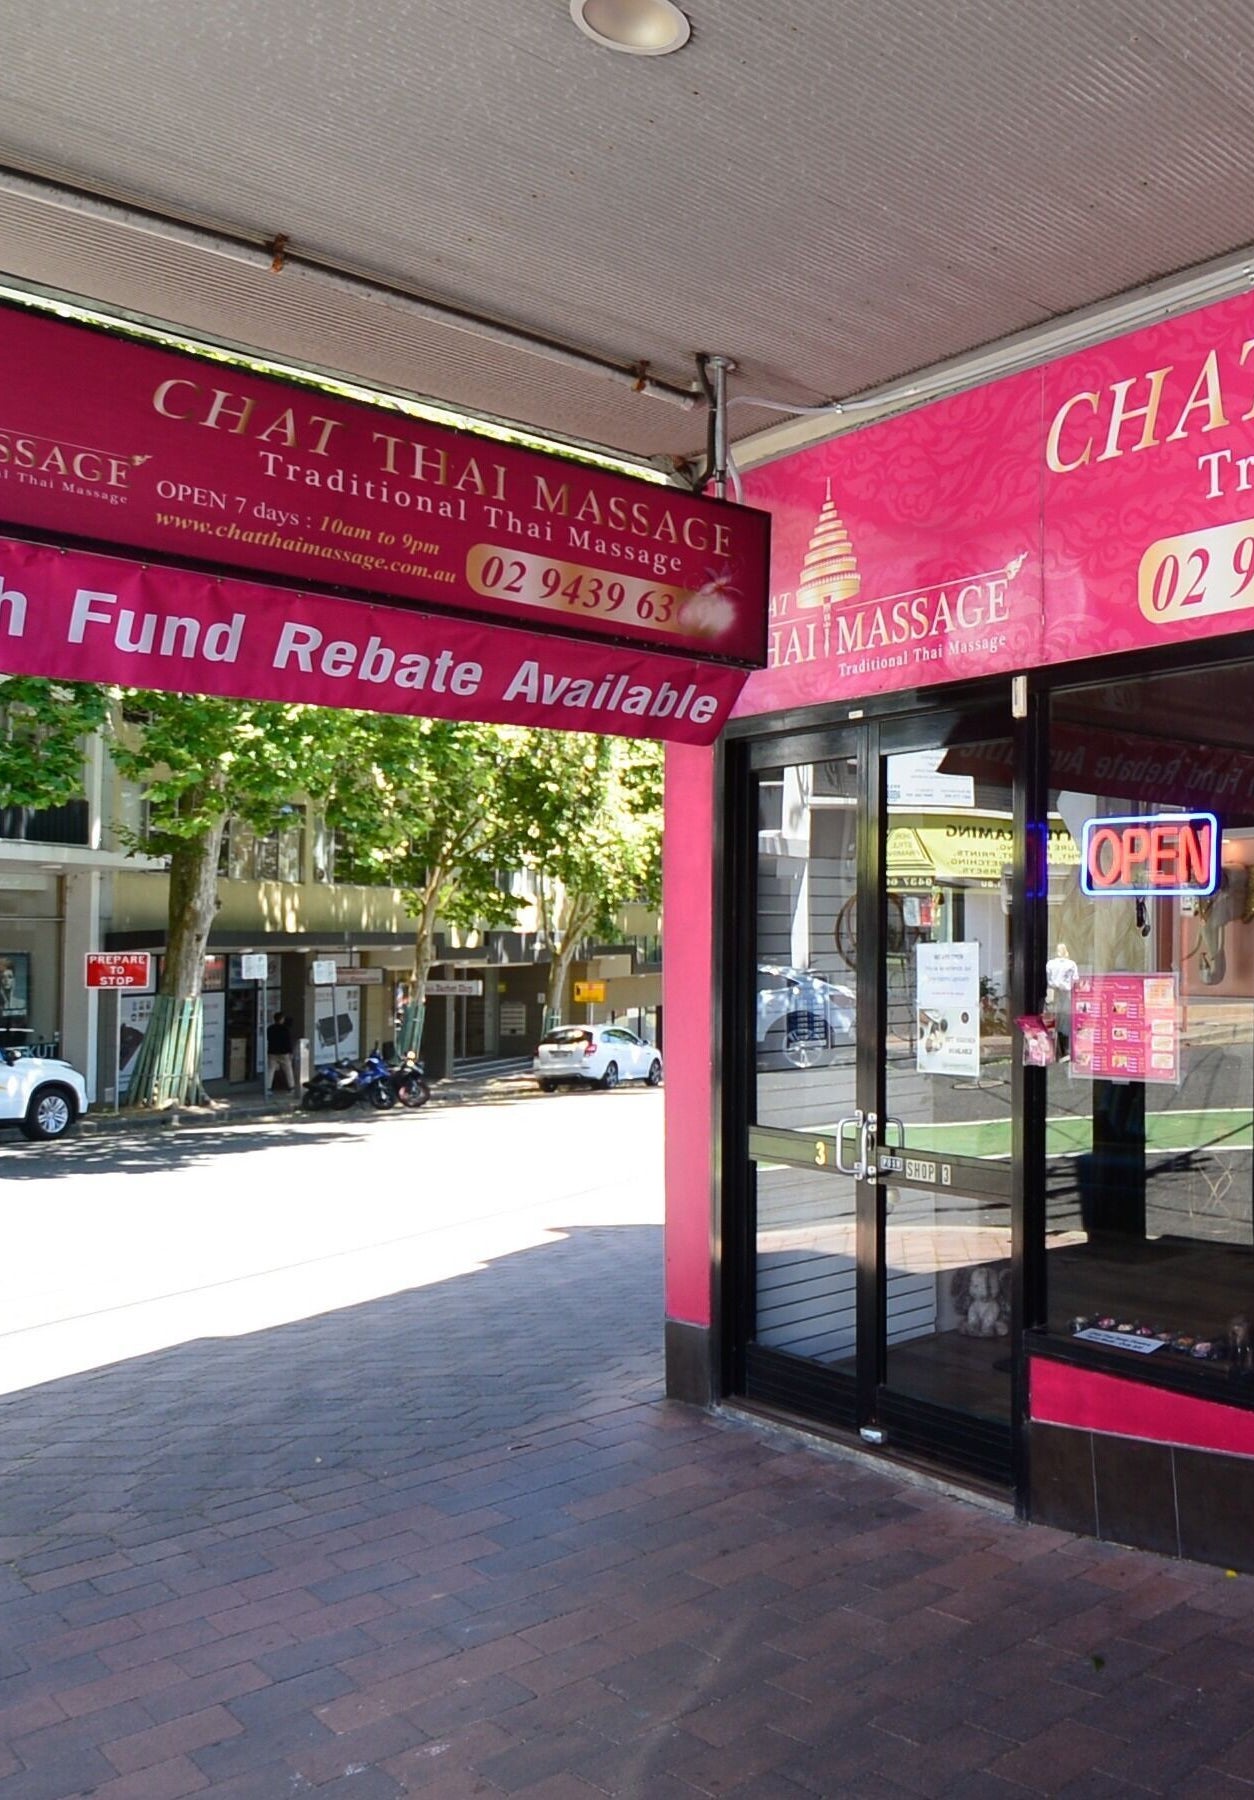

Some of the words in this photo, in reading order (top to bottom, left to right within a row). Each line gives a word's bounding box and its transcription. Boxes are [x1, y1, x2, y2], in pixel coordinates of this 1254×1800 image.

[17, 472, 54, 489] Thai
[62, 482, 128, 505] Massage
[153, 378, 345, 458] CHAT
[373, 431, 507, 501] THAI
[534, 475, 733, 557] MASSAGE
[157, 480, 227, 511] OPEN
[236, 497, 247, 514] 7
[253, 499, 300, 527] days
[319, 515, 371, 541] 10am
[378, 523, 395, 546] to
[401, 534, 440, 557] 9pm
[259, 451, 467, 521] Traditional
[484, 505, 553, 541] Thai
[568, 526, 683, 575] Massage
[156, 510, 457, 584] www.chatthaimassage.com.au
[481, 556, 527, 593] 02
[540, 567, 625, 612] 9439
[636, 590, 676, 623] 63
[1151, 548, 1210, 614] 02
[836, 578, 1010, 656] MASSAGE
[67, 588, 246, 664] Fund
[272, 621, 484, 699] Rebate
[502, 659, 719, 724] Available
[839, 651, 908, 677] Traditional
[914, 643, 942, 663] Thai
[948, 634, 1006, 657] Massage
[1087, 823, 1211, 888] OPEN
[89, 955, 146, 965] PREPARE
[99, 976, 134, 986] STOP
[110, 966, 125, 975] TO
[815, 1141, 827, 1165] 3
[906, 1160, 935, 1182] SHOP
[942, 1165, 950, 1184] 3
